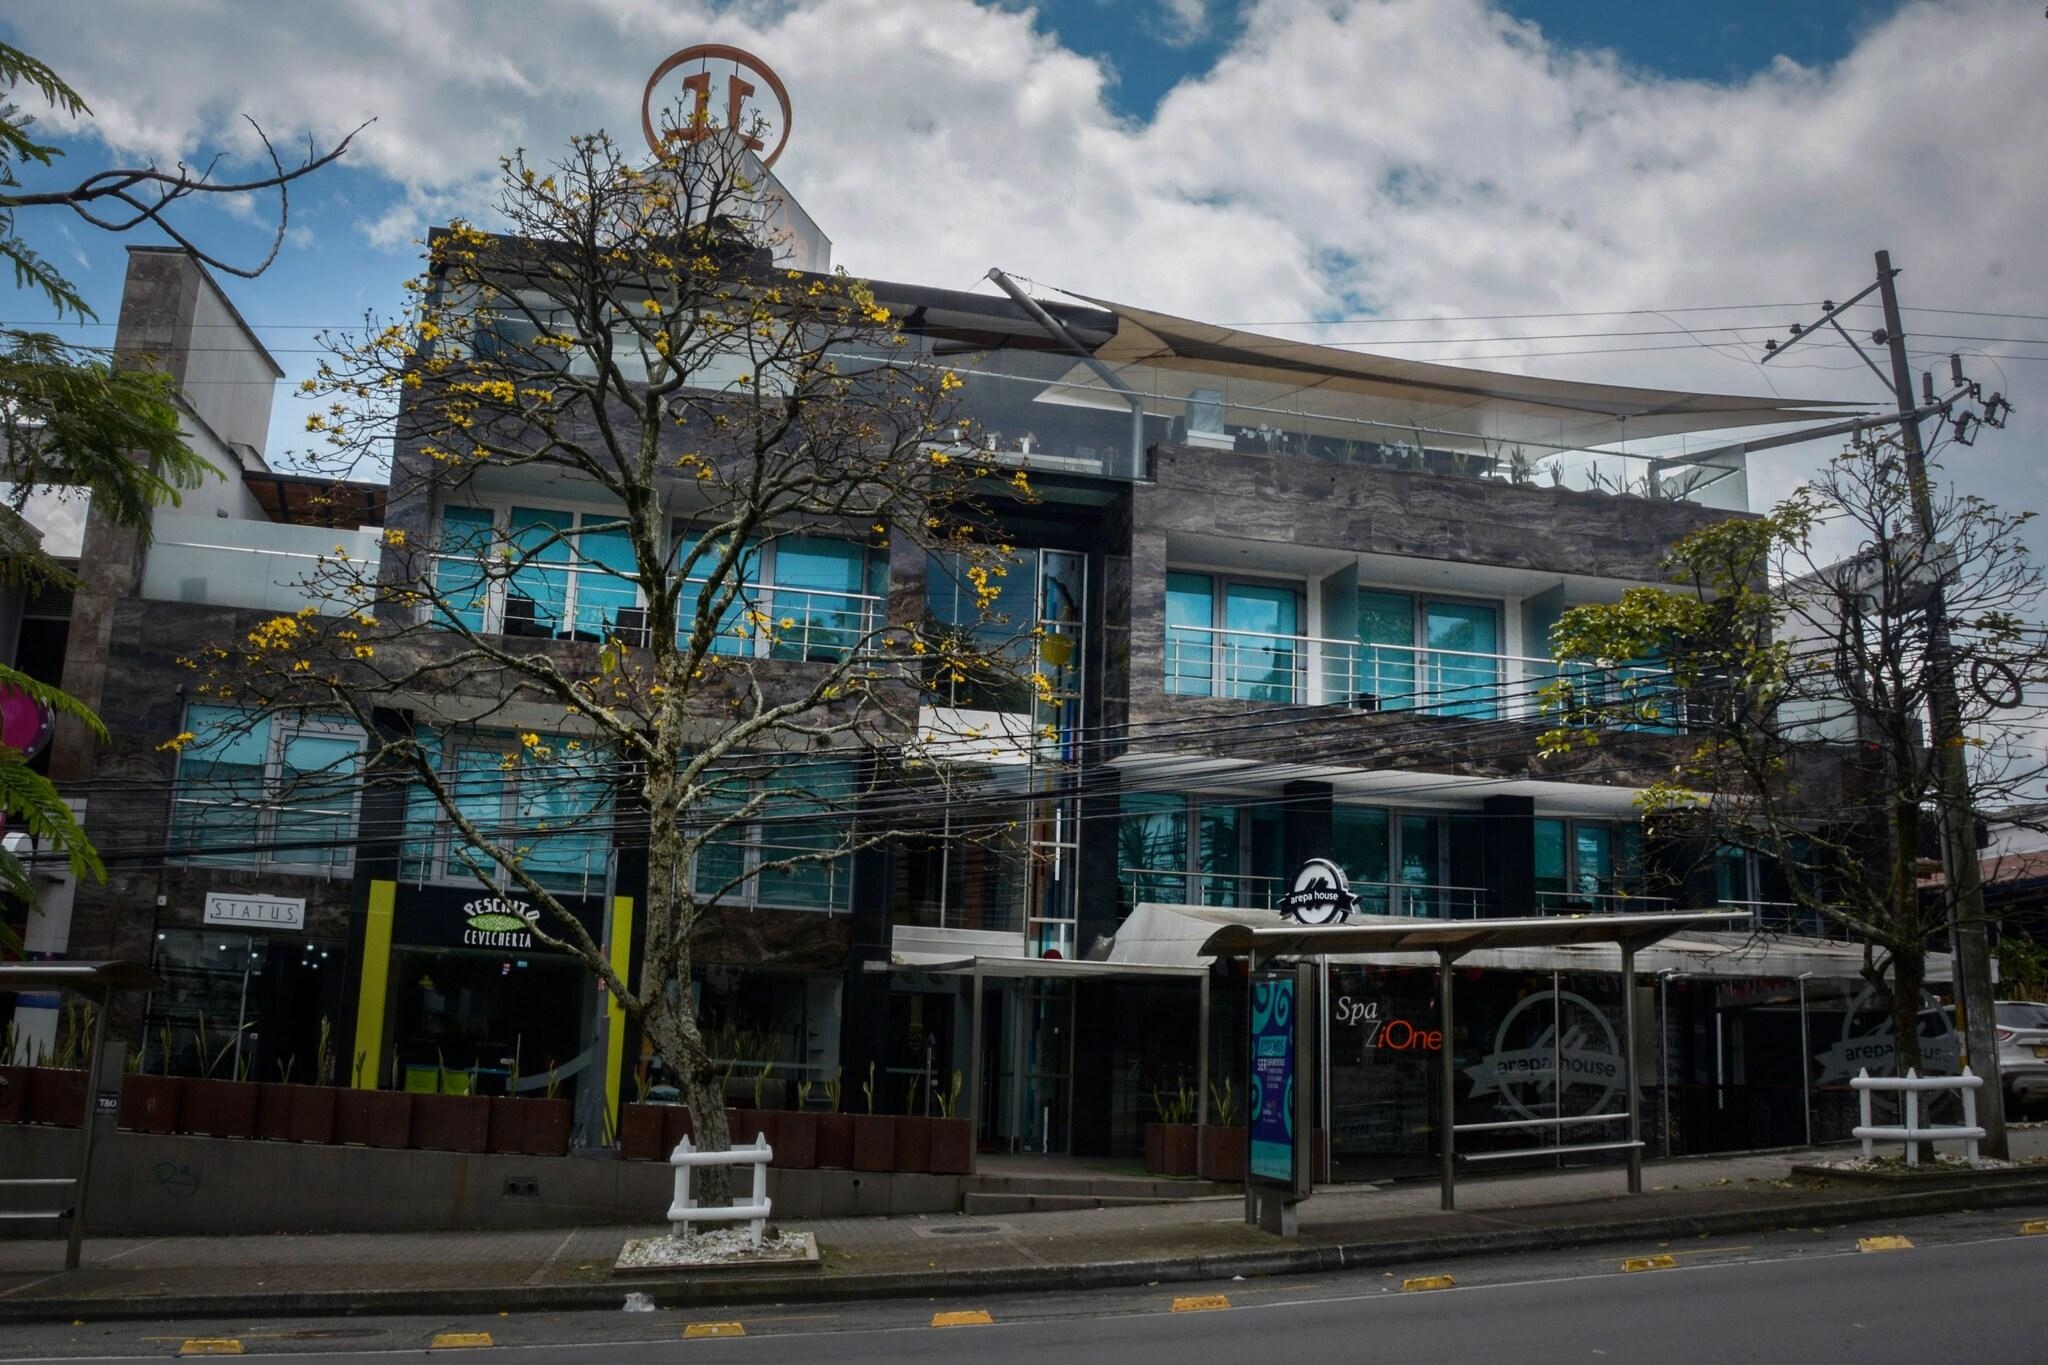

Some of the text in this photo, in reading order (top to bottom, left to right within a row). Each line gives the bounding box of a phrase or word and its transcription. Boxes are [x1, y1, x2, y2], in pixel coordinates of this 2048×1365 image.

[1290, 891, 1339, 905] arepa house
[215, 902, 294, 921] STATUS
[464, 929, 532, 948] CEVICHERIA
[1335, 995, 1379, 1026] Spa
[1365, 1019, 1443, 1051] ZiOne
[1846, 1043, 1894, 1061] arepa
[1497, 1056, 1552, 1077] arepa
